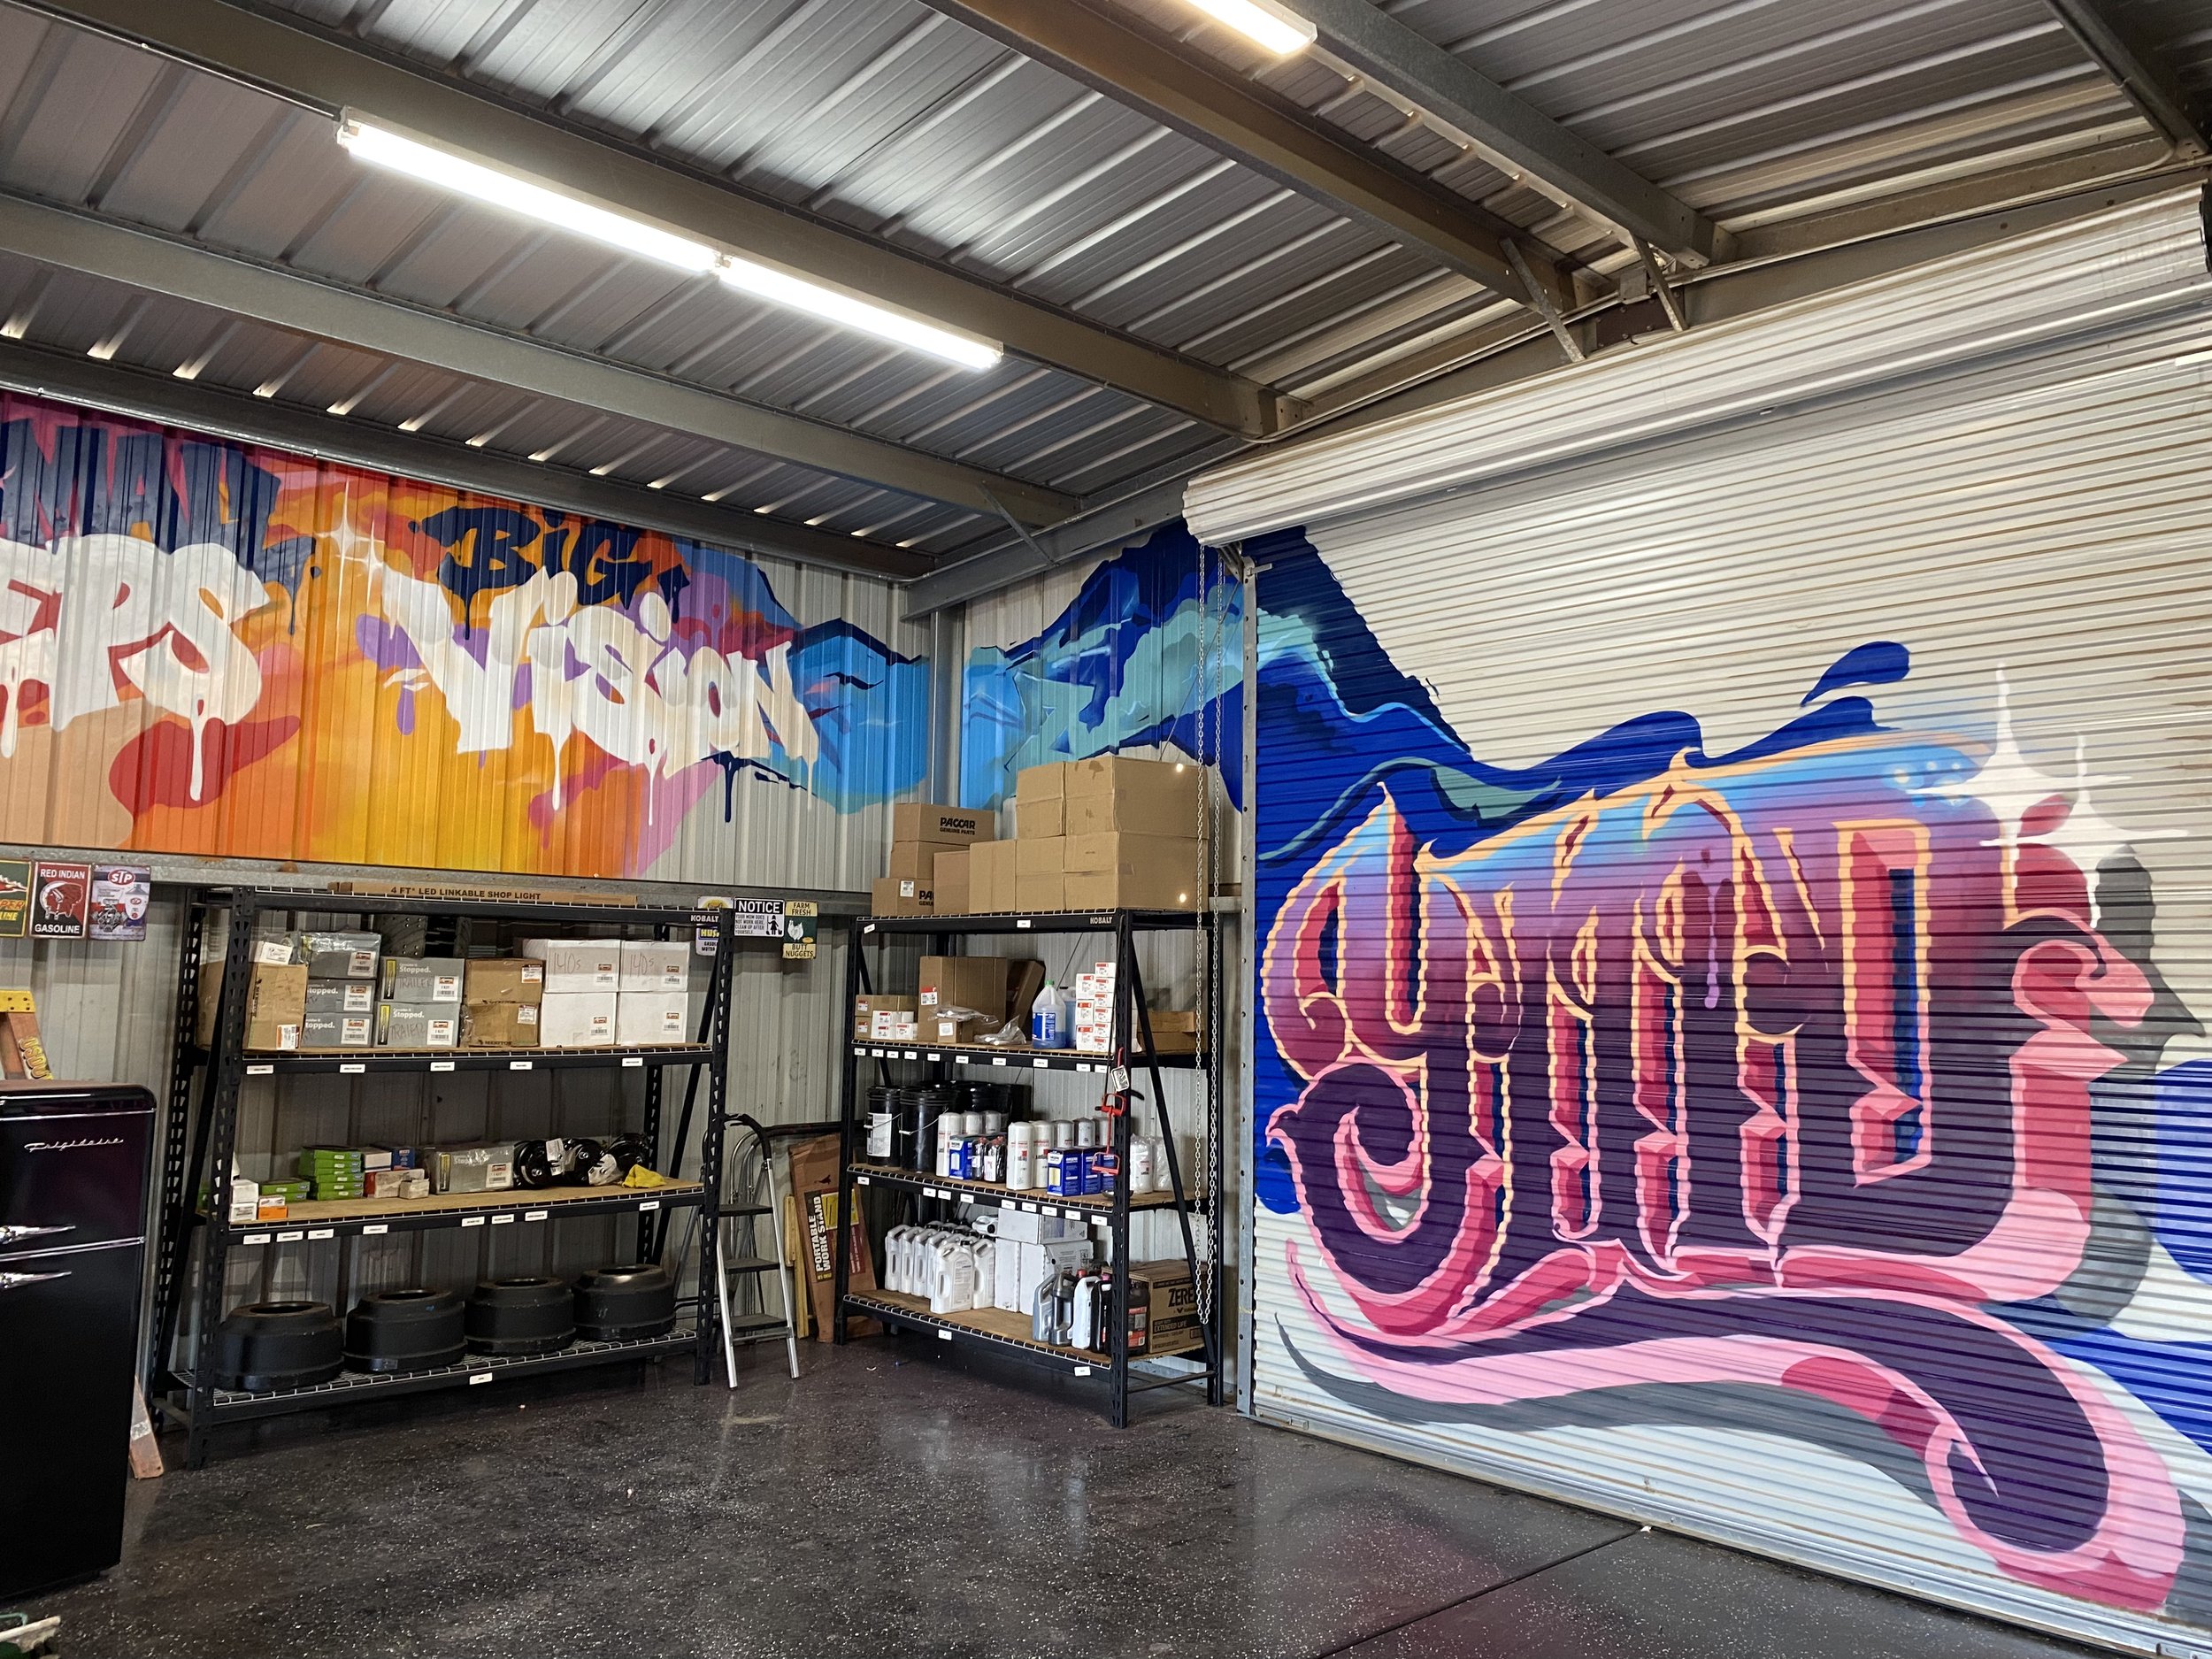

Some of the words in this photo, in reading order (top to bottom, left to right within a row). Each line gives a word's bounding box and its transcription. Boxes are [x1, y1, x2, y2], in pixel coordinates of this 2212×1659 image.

[940, 817, 975, 829] PACCAR
[40, 869, 58, 878] RED
[58, 870, 85, 879] INDIAN
[111, 871, 133, 883] STP
[440, 888, 485, 897] LINKABLE
[738, 900, 780, 913] NOTICE
[35, 924, 81, 933] GASOLINE
[392, 1010, 425, 1019] Stopped.
[24, 1138, 124, 1153] Frigidaire
[813, 1196, 826, 1233] STAND
[809, 1215, 824, 1272] PORTABLE
[818, 1235, 831, 1271] WORK
[1168, 1286, 1195, 1307] ZERE
